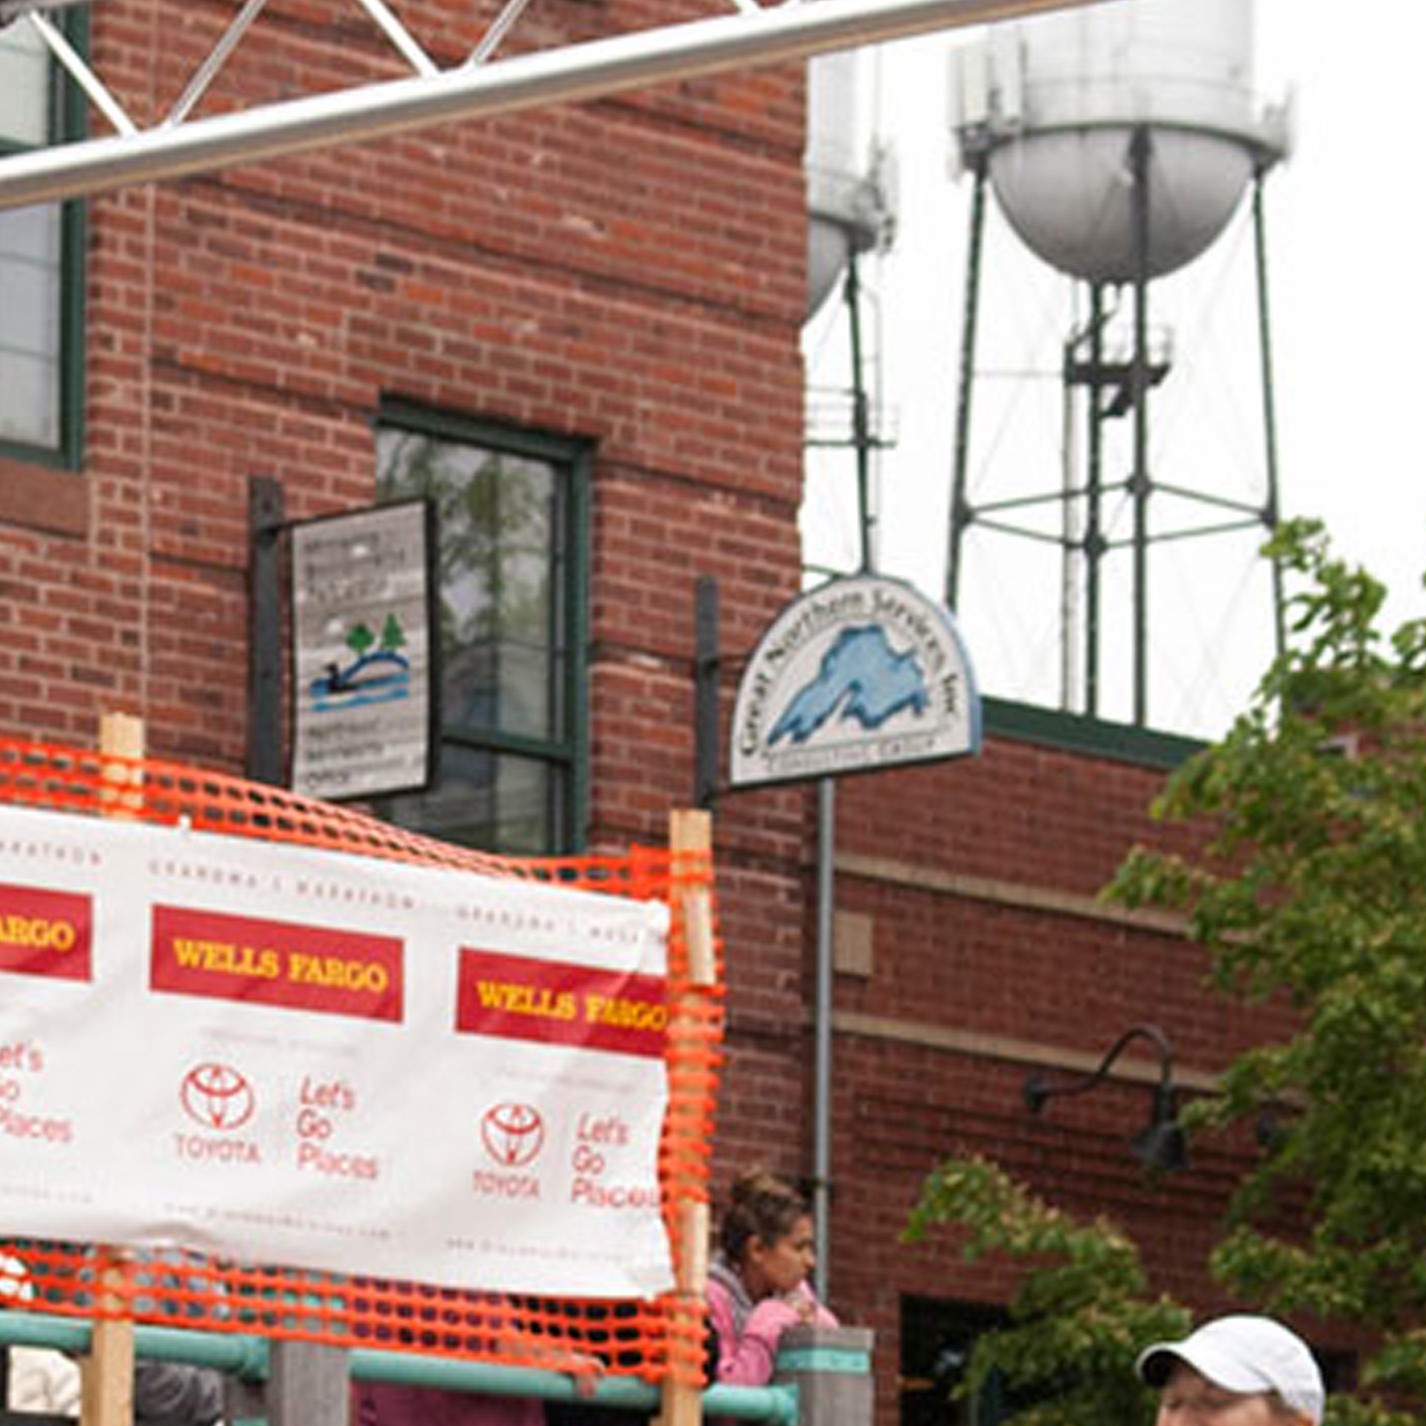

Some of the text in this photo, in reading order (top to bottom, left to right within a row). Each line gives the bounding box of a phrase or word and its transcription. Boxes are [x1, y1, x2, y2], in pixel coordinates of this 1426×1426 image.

[172, 937, 389, 995] WELLS FARGO
[475, 979, 668, 1032] WELLS FARGO
[299, 1074, 357, 1111] Let's
[297, 1106, 333, 1140] Go
[576, 1111, 629, 1147] Let's
[174, 1133, 261, 1164] TOYOTA
[297, 1142, 378, 1181] Places
[572, 1144, 606, 1175] Go
[471, 1169, 541, 1200] TOYOTA
